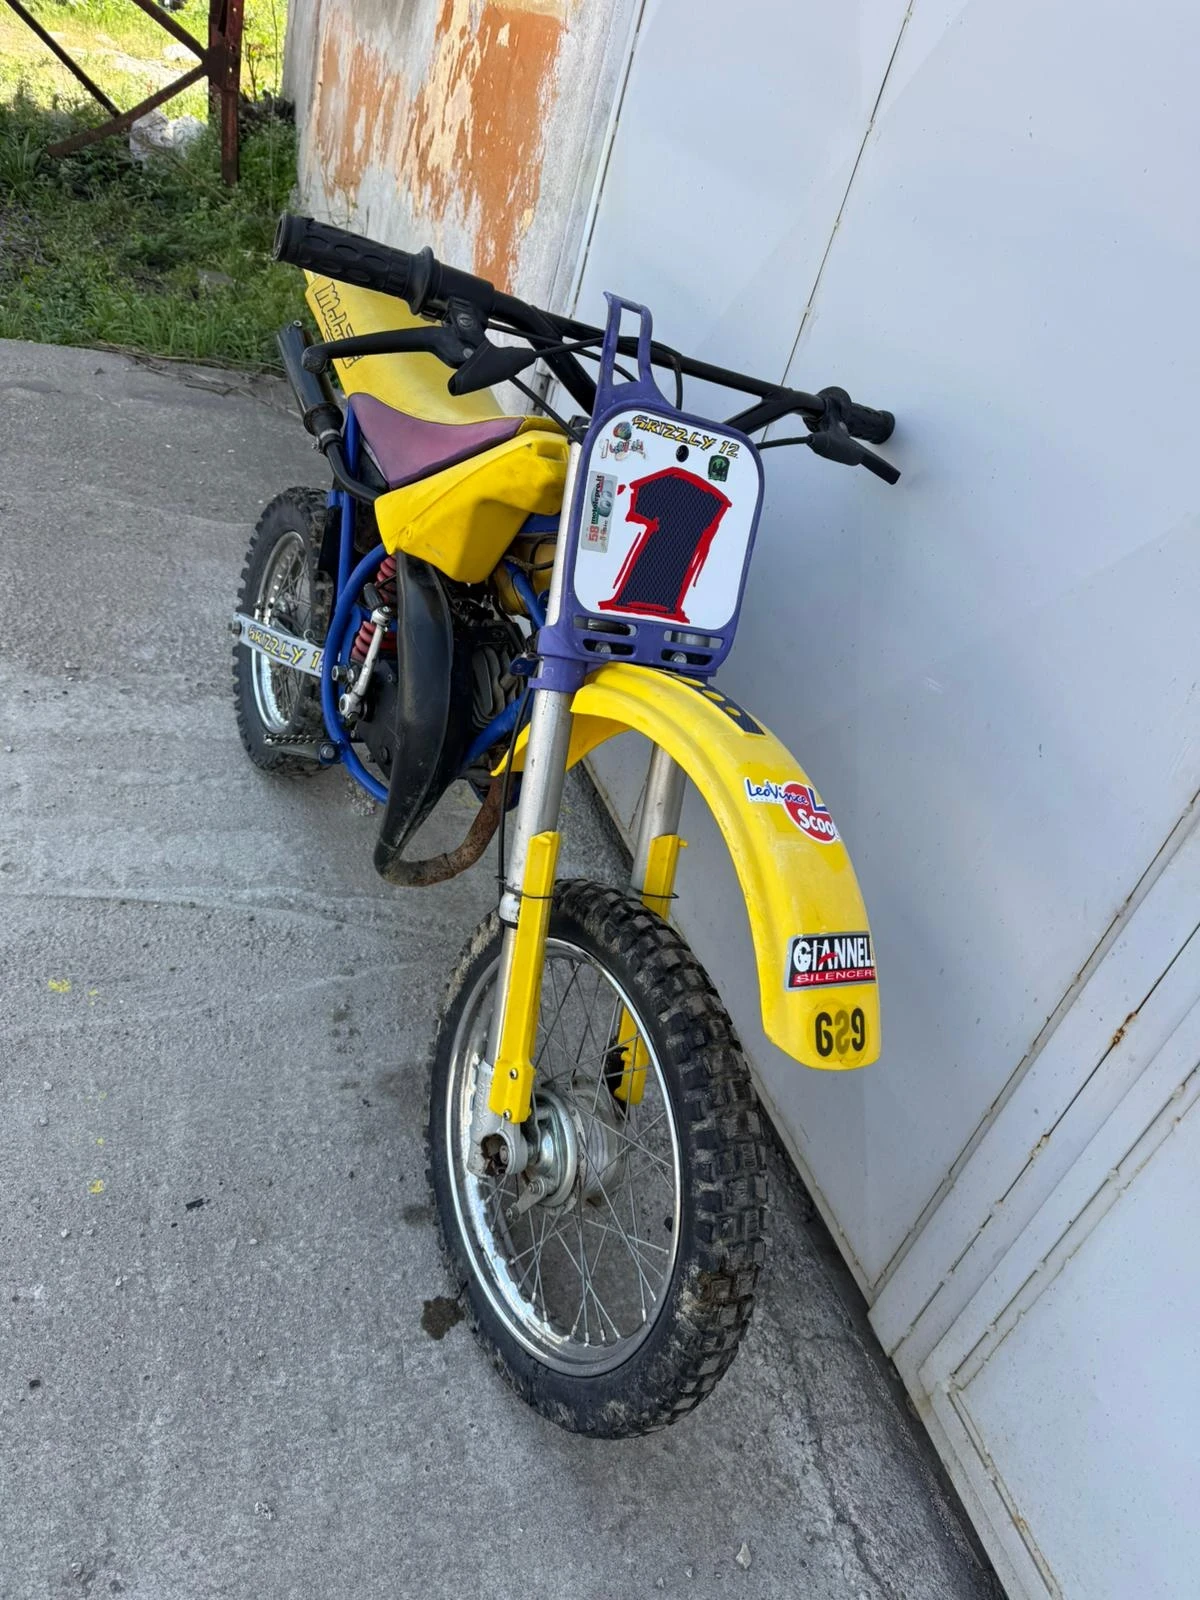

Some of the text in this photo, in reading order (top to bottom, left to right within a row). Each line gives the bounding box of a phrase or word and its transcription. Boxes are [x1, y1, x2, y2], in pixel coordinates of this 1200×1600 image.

[632, 415, 717, 451] GRIZZLY
[719, 440, 740, 458] 12
[588, 525, 600, 542] 58
[598, 467, 732, 624] 1
[311, 650, 323, 672] 1
[745, 778, 810, 806] LeoVince
